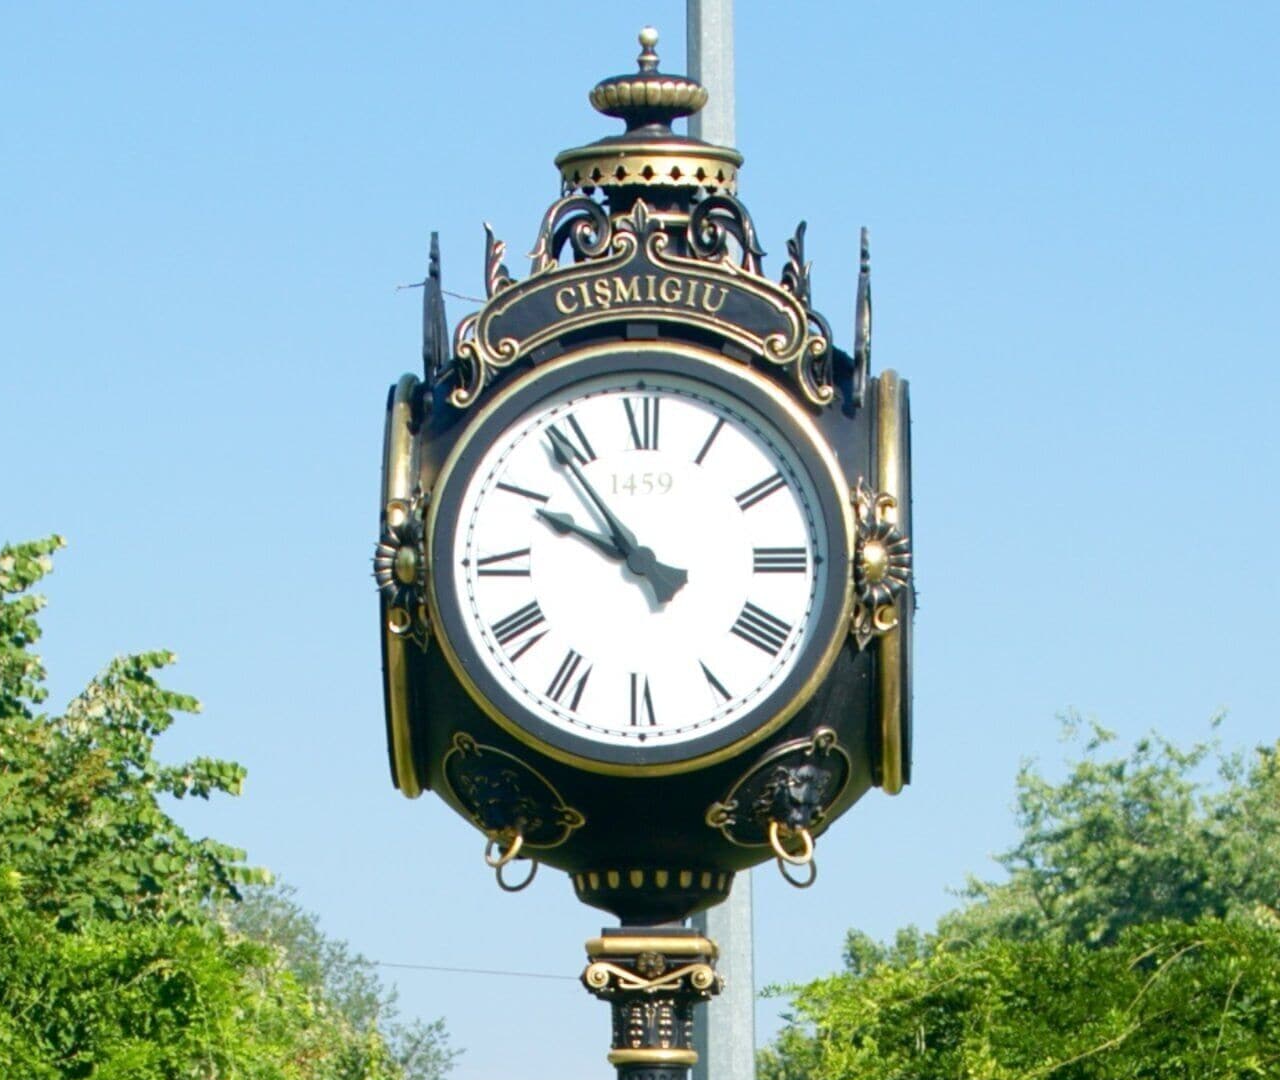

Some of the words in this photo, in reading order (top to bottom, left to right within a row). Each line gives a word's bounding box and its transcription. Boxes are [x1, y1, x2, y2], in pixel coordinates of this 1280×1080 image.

[618, 397, 662, 451] XII
[610, 472, 674, 496] 1459
[735, 472, 787, 510] II
[753, 547, 807, 573] III
